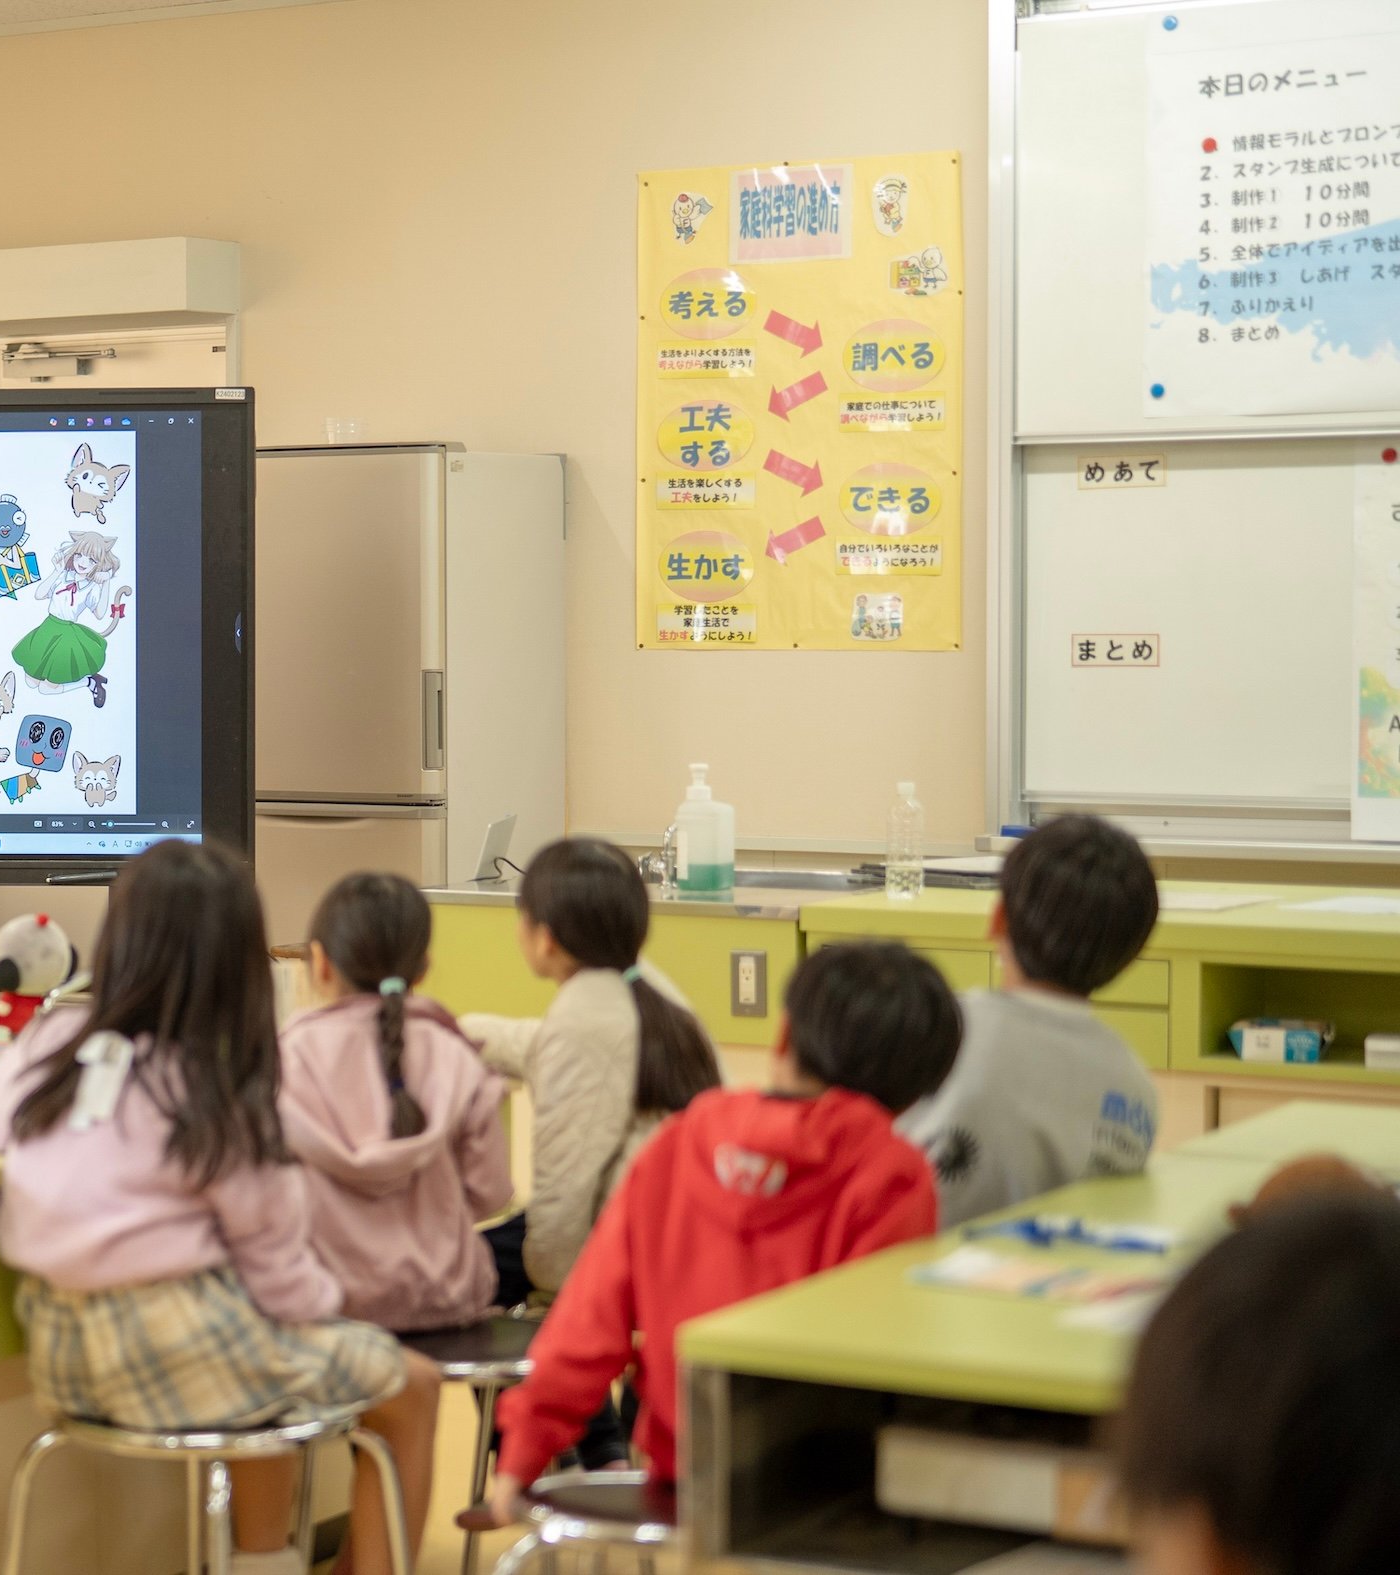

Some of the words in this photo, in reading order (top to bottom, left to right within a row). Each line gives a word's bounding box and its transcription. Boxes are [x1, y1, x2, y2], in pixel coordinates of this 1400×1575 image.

[1198, 67, 1367, 99] 本日のメニュー
[739, 180, 841, 240] 家庭科学習の進め方
[668, 289, 747, 320] 考える
[1230, 295, 1314, 315] ふりかえり
[1230, 325, 1280, 343] まとめ
[851, 341, 935, 372] 調べる
[679, 403, 732, 433] 工夫
[680, 440, 731, 467] する
[668, 478, 742, 489] 生活を楽しくする
[1085, 459, 1161, 484] めあて
[849, 486, 931, 515] できる
[839, 544, 938, 554] 自分でいろいろなことが
[667, 552, 744, 581] 生かす
[1077, 638, 1154, 662] まとめ
